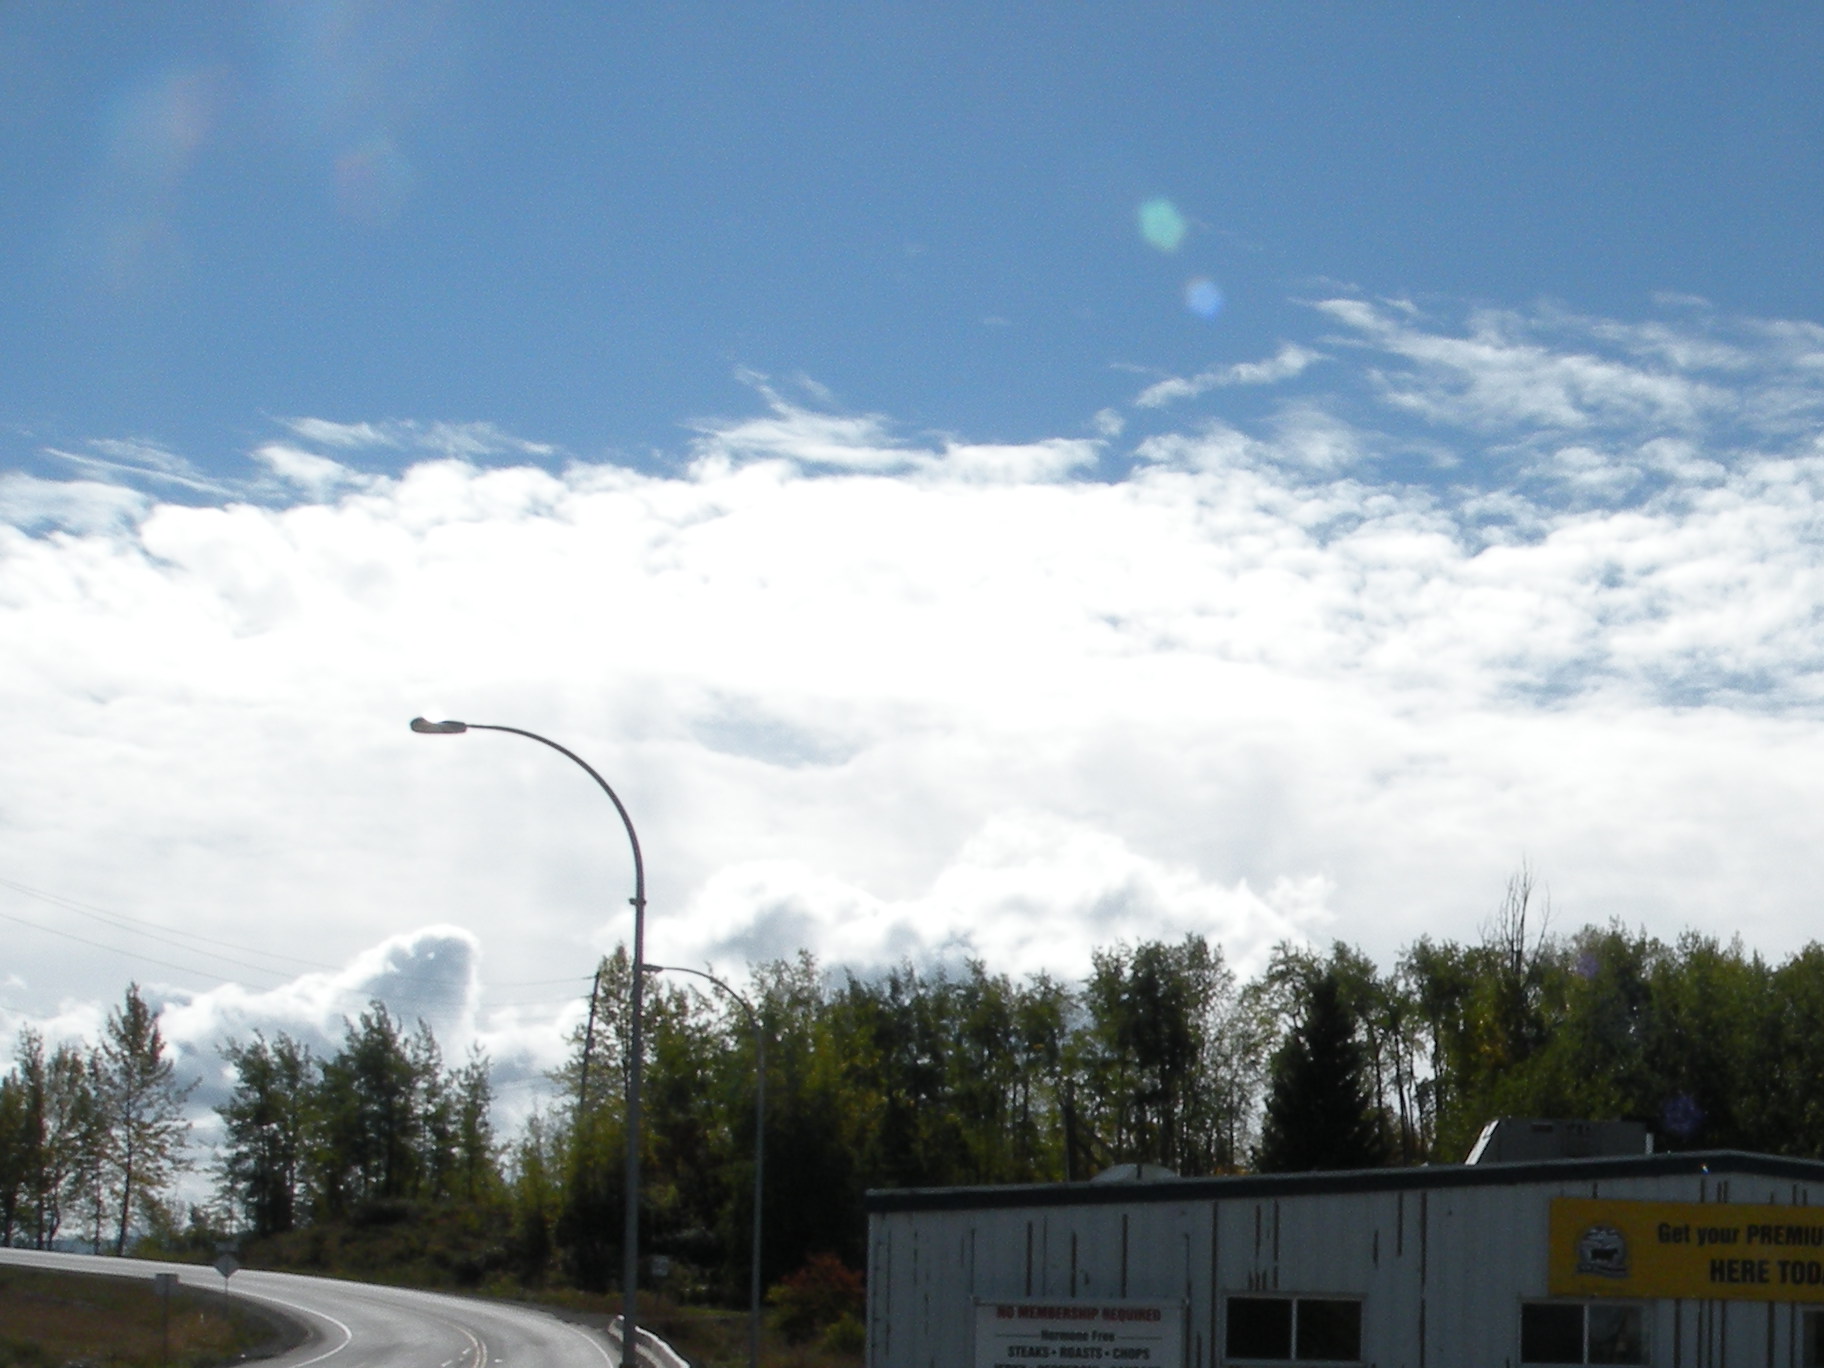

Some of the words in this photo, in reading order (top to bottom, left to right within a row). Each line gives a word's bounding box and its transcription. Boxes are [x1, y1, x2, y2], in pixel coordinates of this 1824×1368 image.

[1657, 1222, 1690, 1244] Get
[1697, 1226, 1740, 1246] your
[1709, 1259, 1770, 1284] HERE
[996, 1306, 1014, 1319] NO
[1018, 1306, 1099, 1320] MEMBERSHIP
[1102, 1308, 1161, 1321] REQUIRED
[1092, 1330, 1115, 1342] Free
[1008, 1346, 1049, 1358] STEAKS
[1060, 1347, 1102, 1359] ROASTS
[1113, 1348, 1150, 1359] CHOPS
